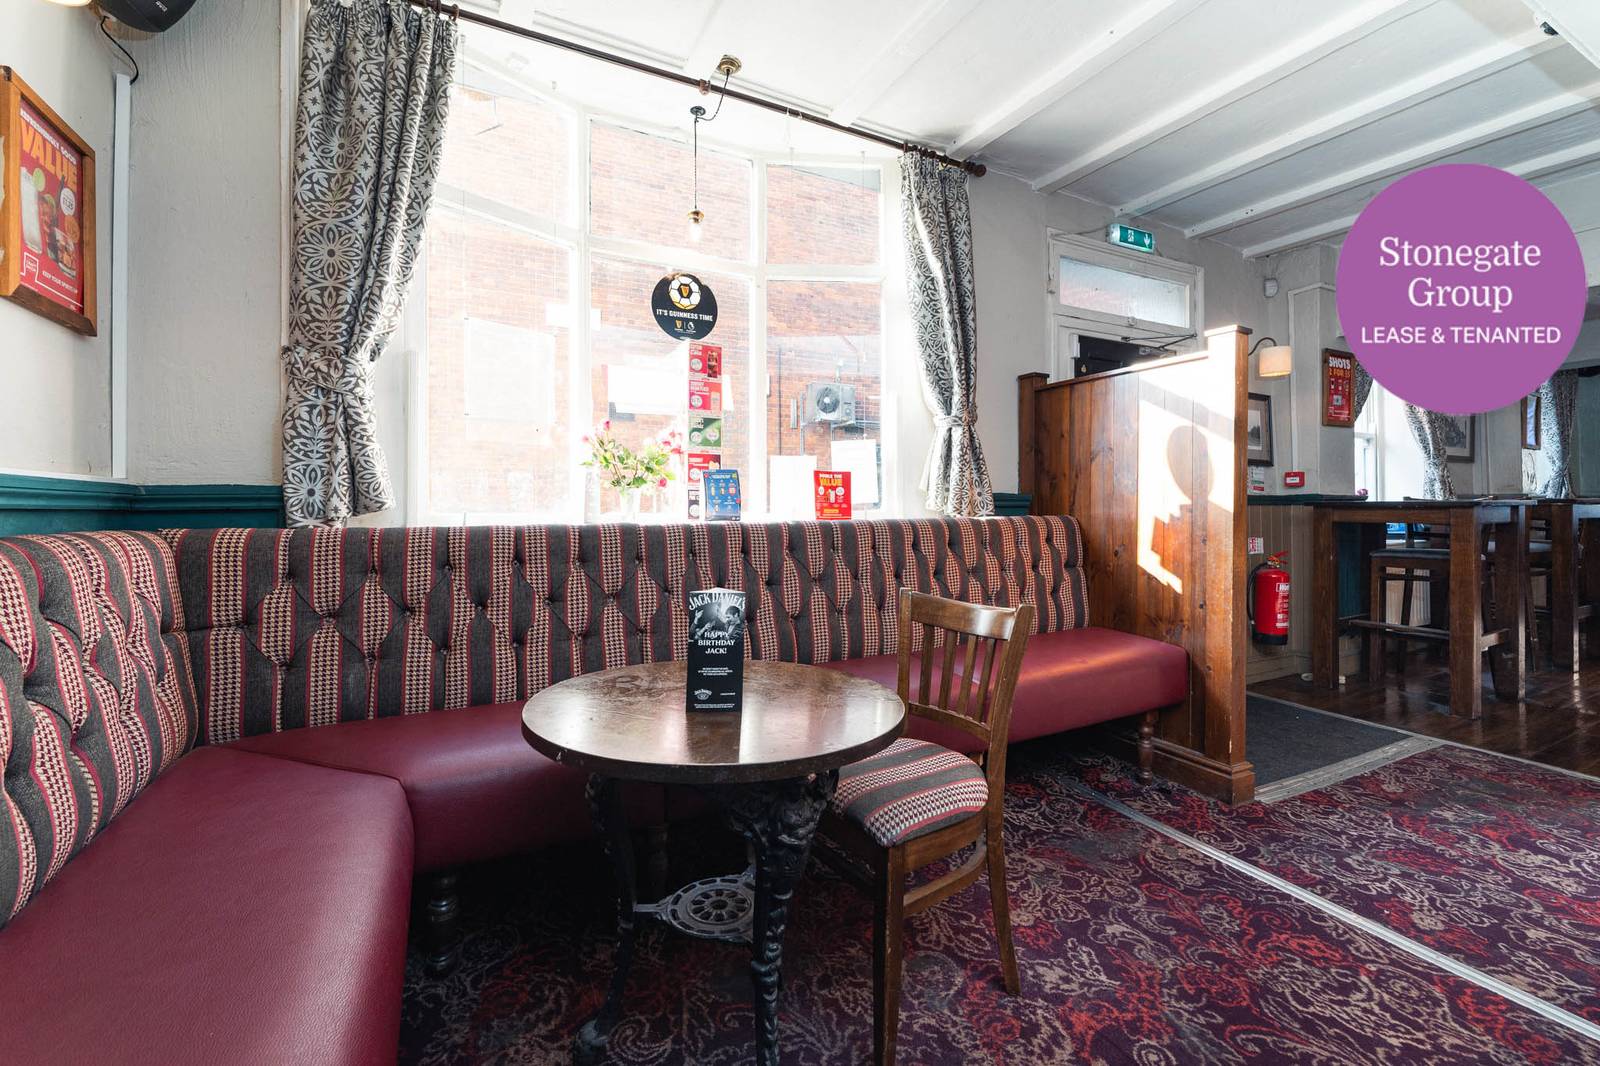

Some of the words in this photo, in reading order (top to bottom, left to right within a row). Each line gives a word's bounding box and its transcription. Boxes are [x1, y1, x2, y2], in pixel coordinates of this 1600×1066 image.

[21, 118, 77, 192] VALUE
[669, 311, 698, 319] GUINNESS
[1329, 356, 1351, 370] SHOTS
[689, 593, 711, 610] JACK
[712, 591, 746, 611] DANIEL'S
[704, 631, 729, 640] HAPPY
[698, 639, 736, 647] BIRTHDAY
[705, 647, 727, 655] JACK!
